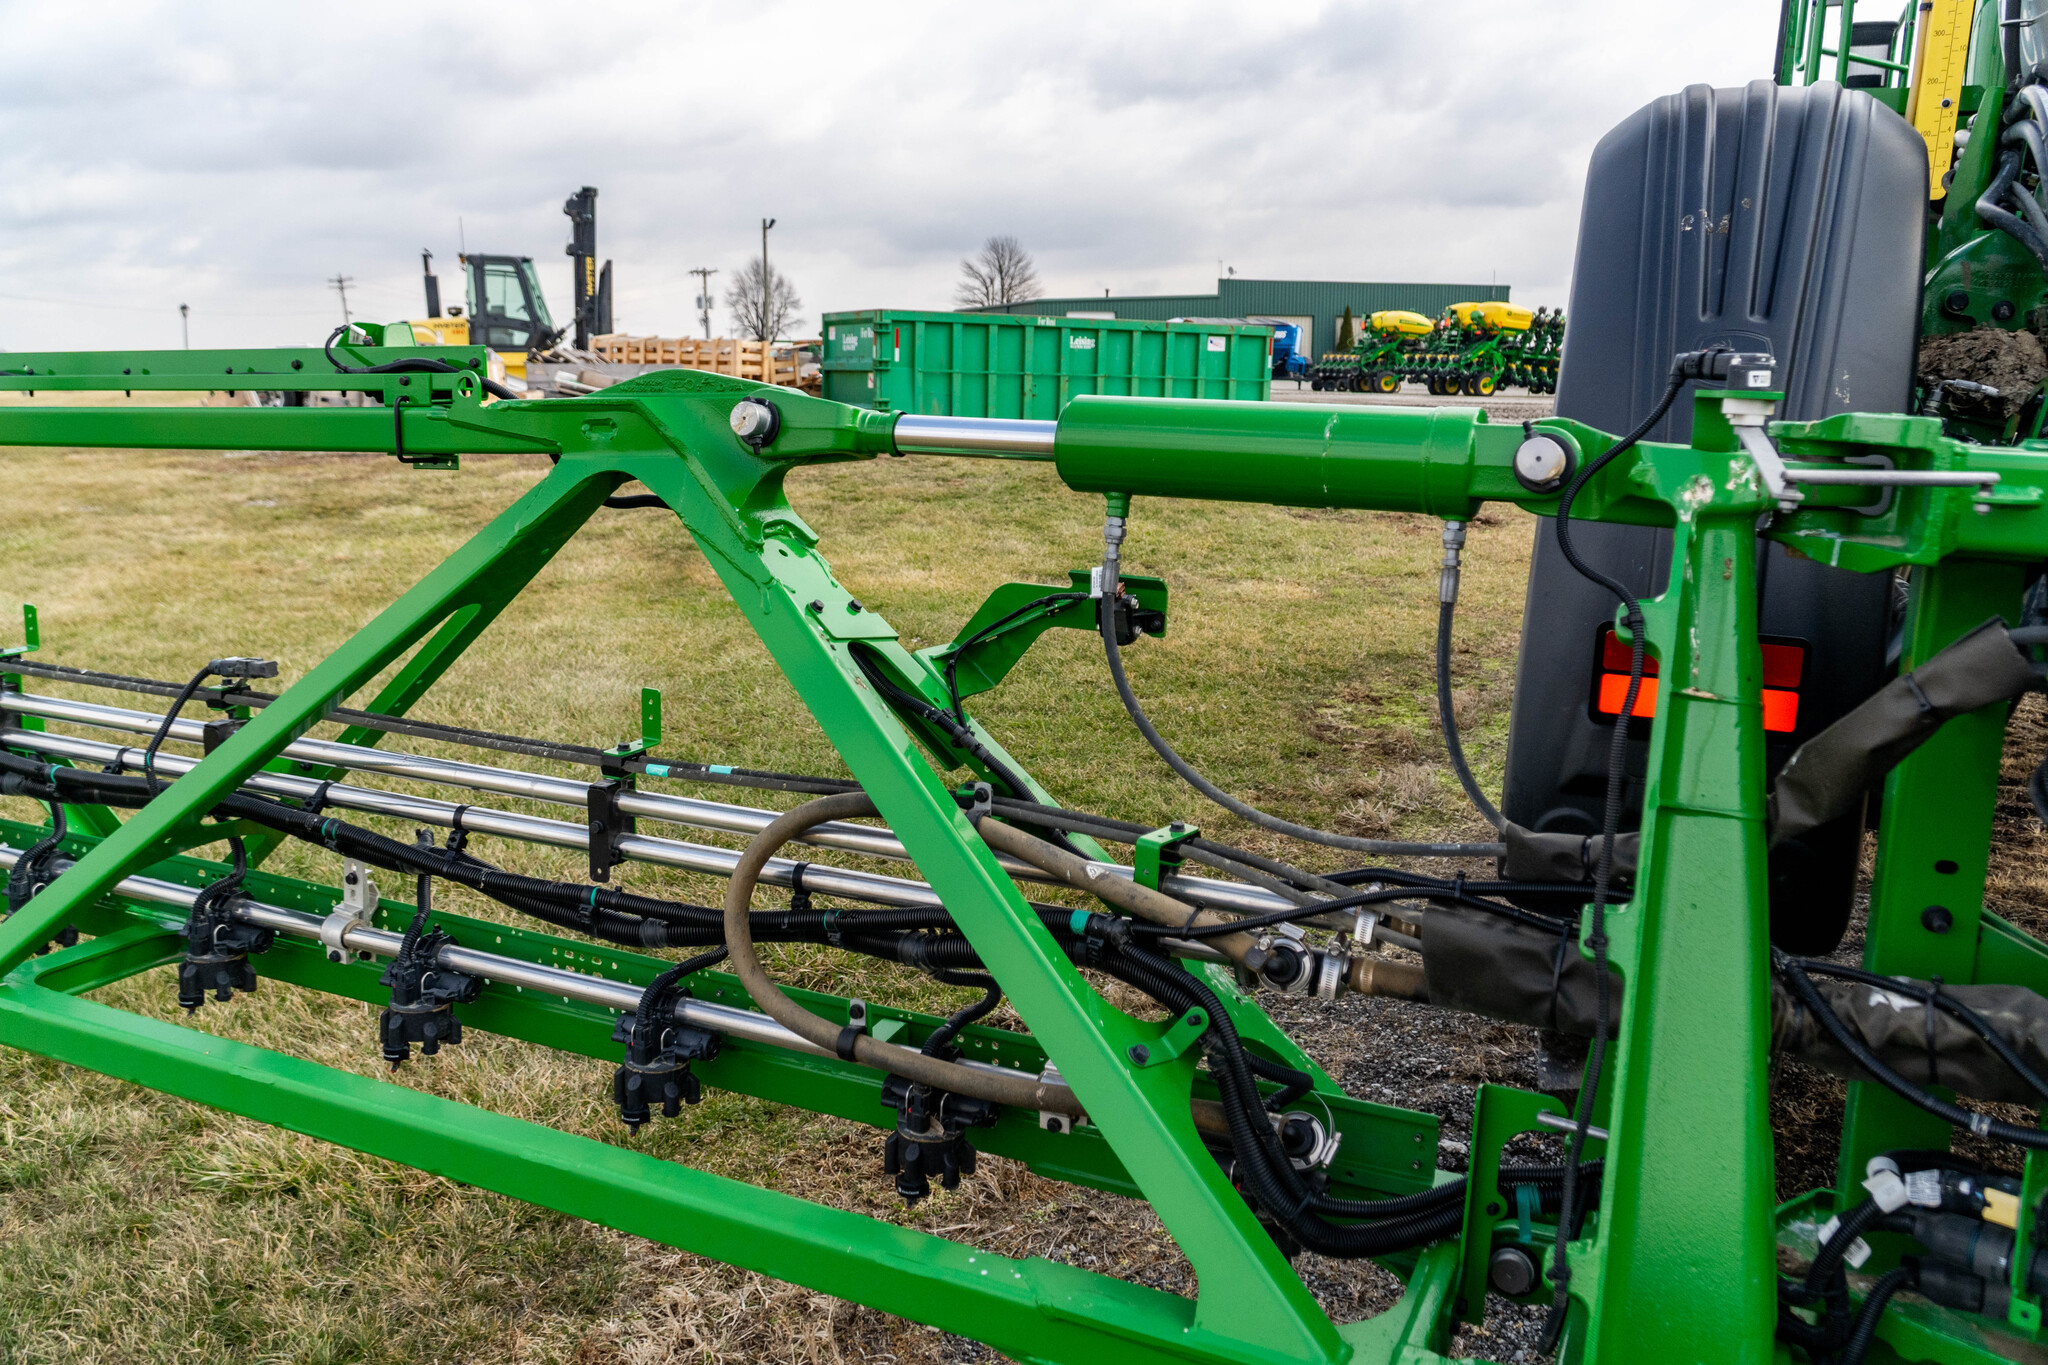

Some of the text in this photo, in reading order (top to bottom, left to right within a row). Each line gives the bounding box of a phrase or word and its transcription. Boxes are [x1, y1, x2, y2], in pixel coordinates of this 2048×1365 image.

[1933, 29, 1946, 37] 300
[1959, 44, 1967, 52] 10
[1926, 77, 1938, 85] 200
[1949, 110, 1954, 118] 5
[1069, 335, 1096, 349] Leising
